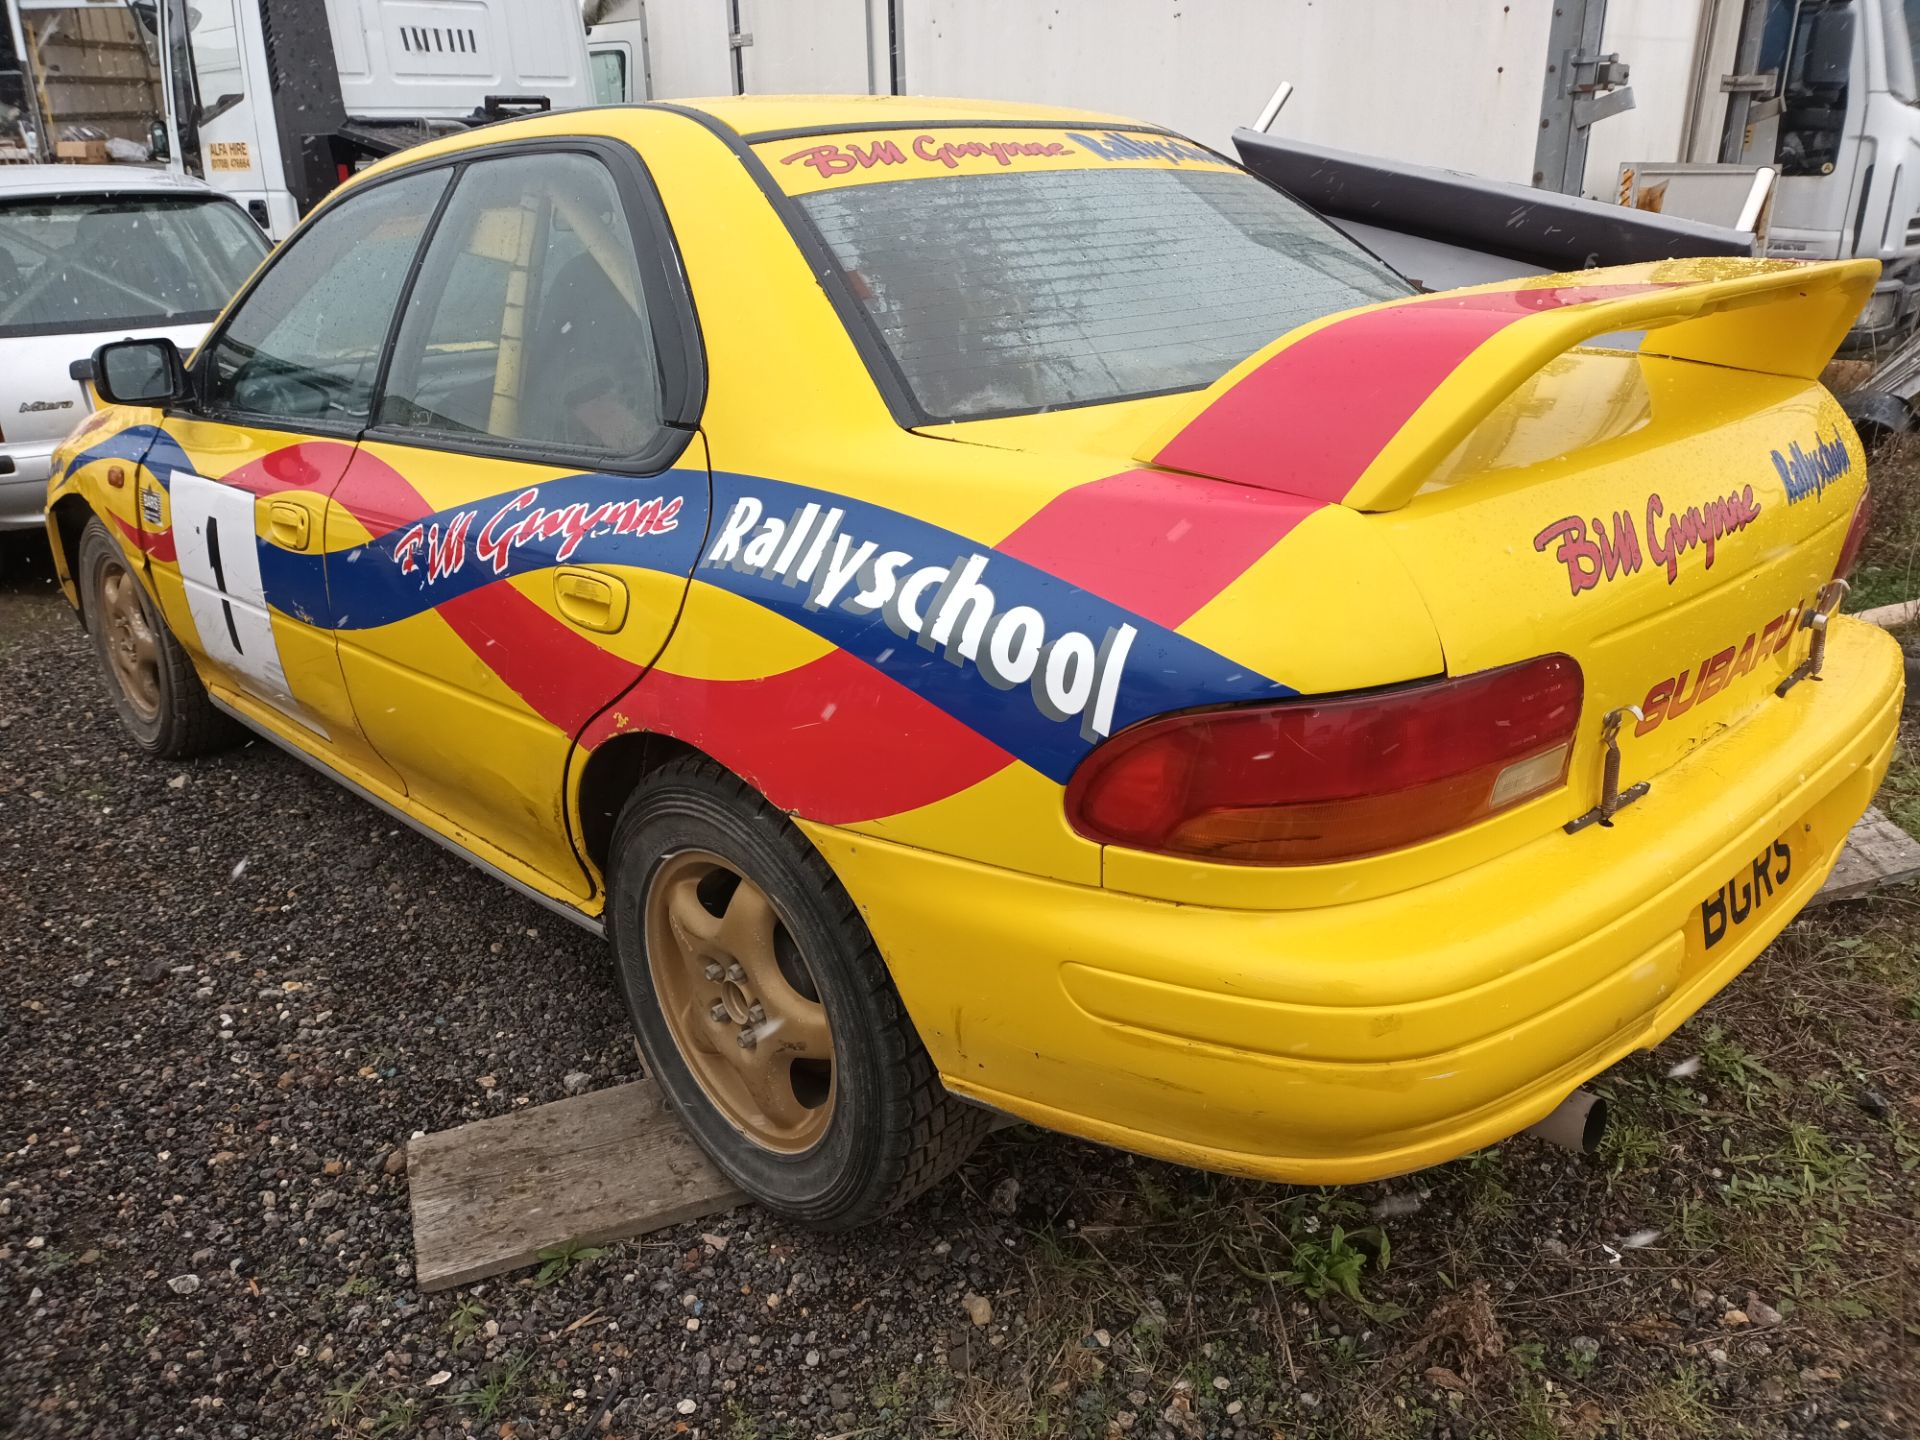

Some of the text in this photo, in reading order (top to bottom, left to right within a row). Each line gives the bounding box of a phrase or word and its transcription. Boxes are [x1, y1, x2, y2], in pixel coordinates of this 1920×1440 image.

[210, 142, 247, 156] ALFA HIRE
[780, 132, 1237, 178] Bill Gwynne Rallysch
[206, 516, 244, 655] 1
[1534, 511, 1643, 596] Bill
[1647, 484, 1761, 585] Gwynne
[476, 488, 684, 575] Gwynne
[703, 497, 1138, 745] Rallyschool
[1635, 599, 1805, 738] SUBARU
[1701, 839, 1791, 950] BGRS
